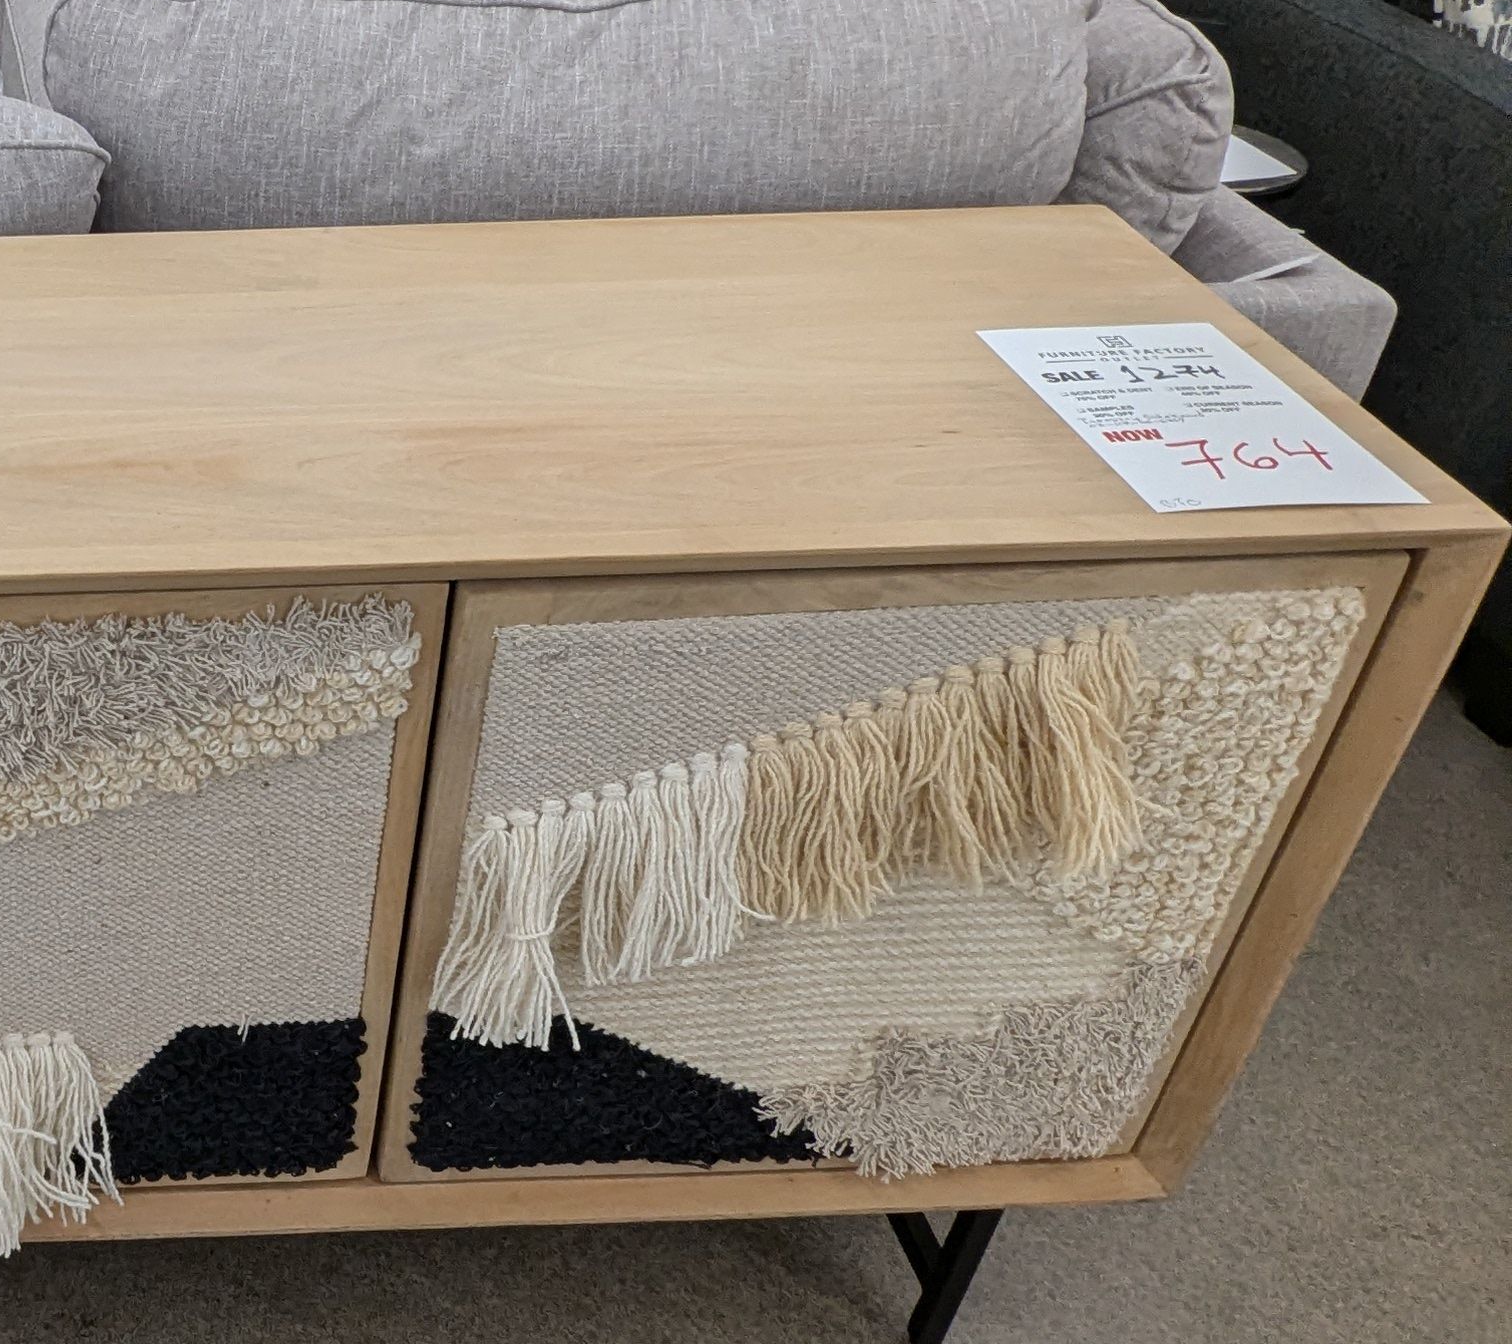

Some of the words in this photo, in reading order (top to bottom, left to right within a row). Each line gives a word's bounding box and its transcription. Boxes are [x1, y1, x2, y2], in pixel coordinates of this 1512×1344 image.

[1038, 348, 1128, 359] FURNITURE
[1133, 346, 1205, 356] FACTORY
[1042, 370, 1104, 383] SALE
[1119, 364, 1226, 383] 1274
[1102, 428, 1164, 443] NOW
[1165, 437, 1334, 480] 764
